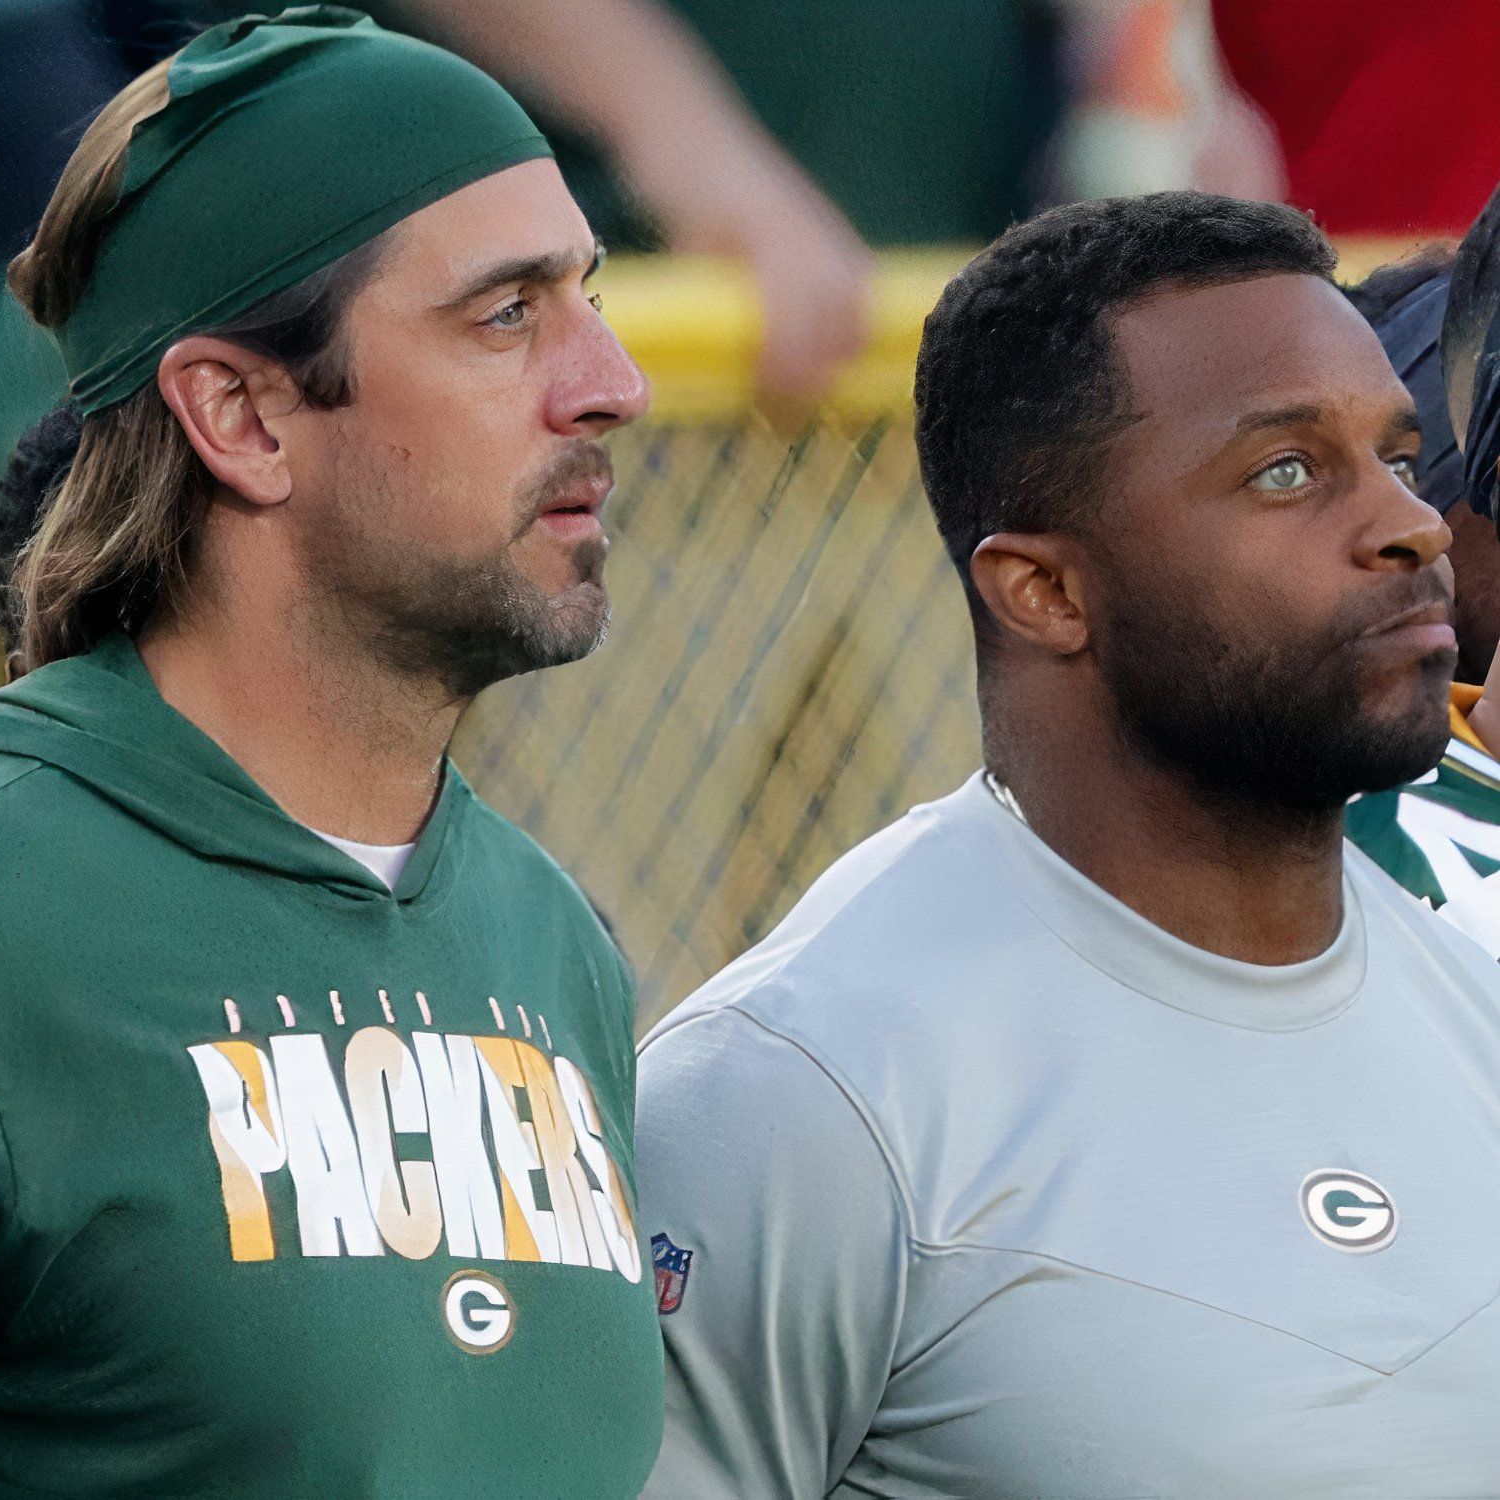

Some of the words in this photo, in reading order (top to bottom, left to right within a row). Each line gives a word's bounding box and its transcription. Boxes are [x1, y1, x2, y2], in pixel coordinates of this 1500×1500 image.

[187, 1026, 642, 1284] PACKERS
[1305, 1178, 1392, 1242] G
[444, 1277, 511, 1347] G
